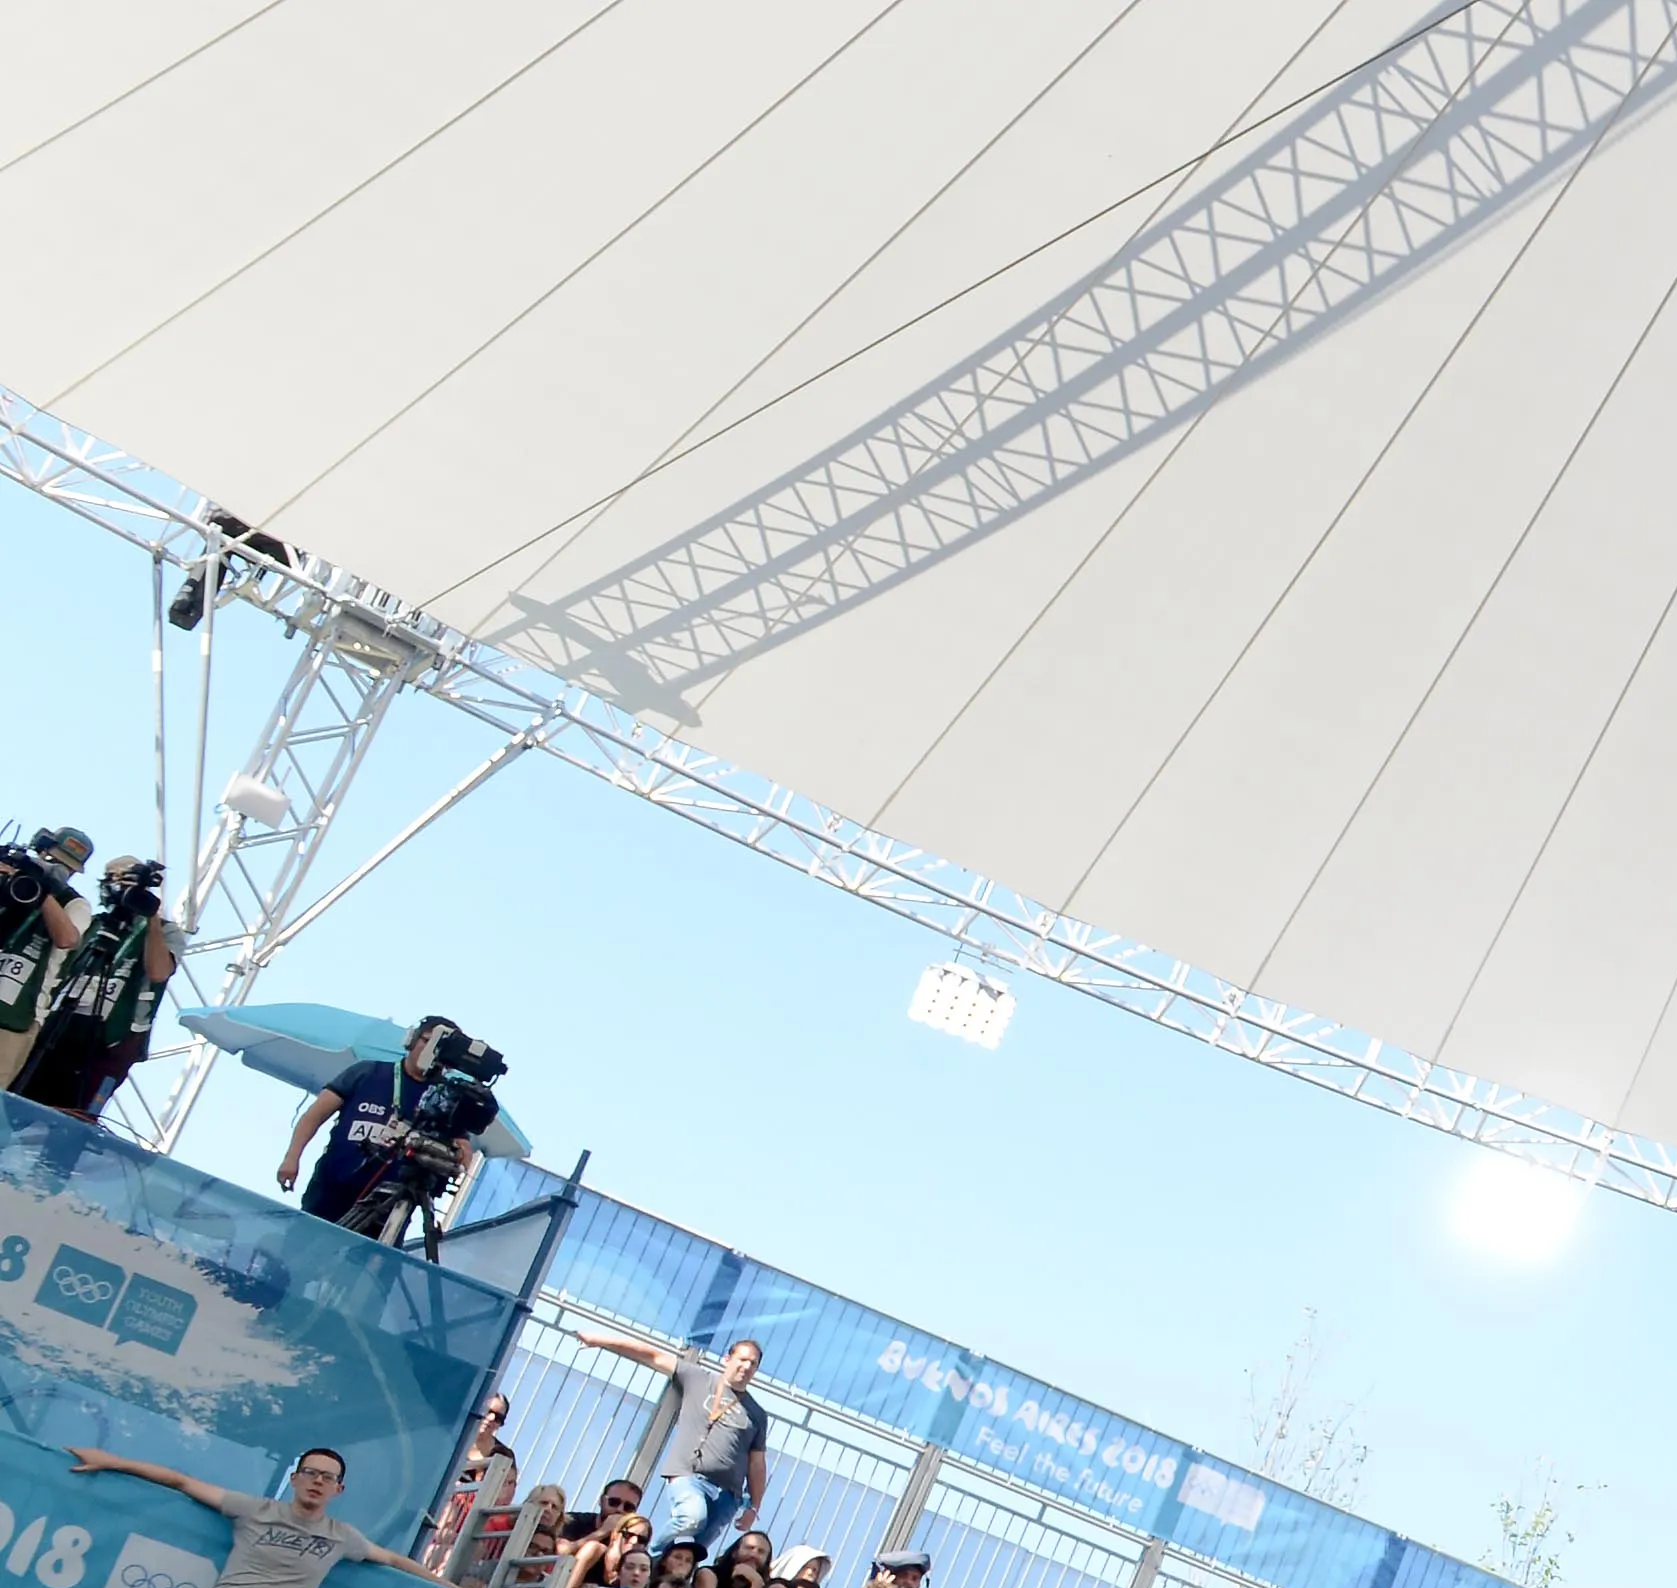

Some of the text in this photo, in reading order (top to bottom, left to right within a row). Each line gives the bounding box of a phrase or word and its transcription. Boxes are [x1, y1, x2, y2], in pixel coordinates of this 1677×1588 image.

[358, 1102, 386, 1116] OBS
[139, 1287, 184, 1313] YOUTH
[124, 1300, 185, 1330] OLYMPIC
[123, 1316, 173, 1342] GAMES
[877, 1339, 1177, 1489] BUENOS AIRES 2018
[974, 1424, 1144, 1514] Feel the future
[258, 1527, 310, 1548] NICE
